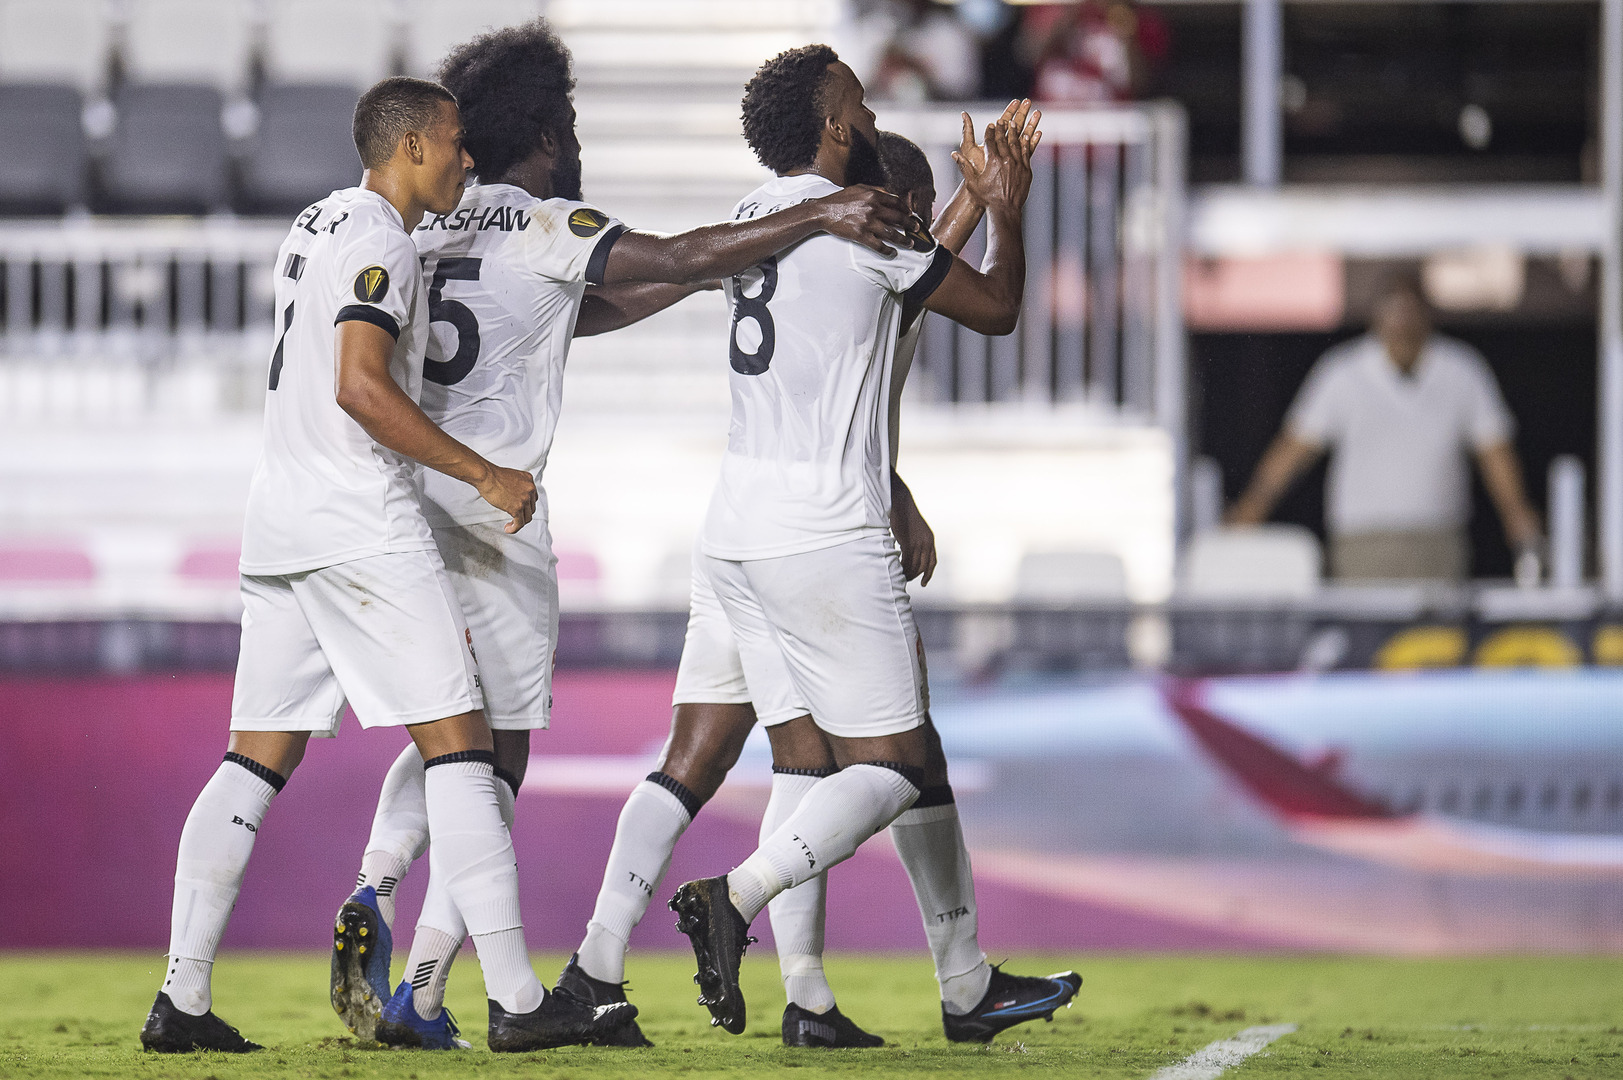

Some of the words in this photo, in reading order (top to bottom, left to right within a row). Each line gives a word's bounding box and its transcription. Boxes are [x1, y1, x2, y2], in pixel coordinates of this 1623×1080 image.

[730, 255, 778, 376] 8
[793, 834, 816, 869] TTFA
[937, 906, 970, 923] TTFA
